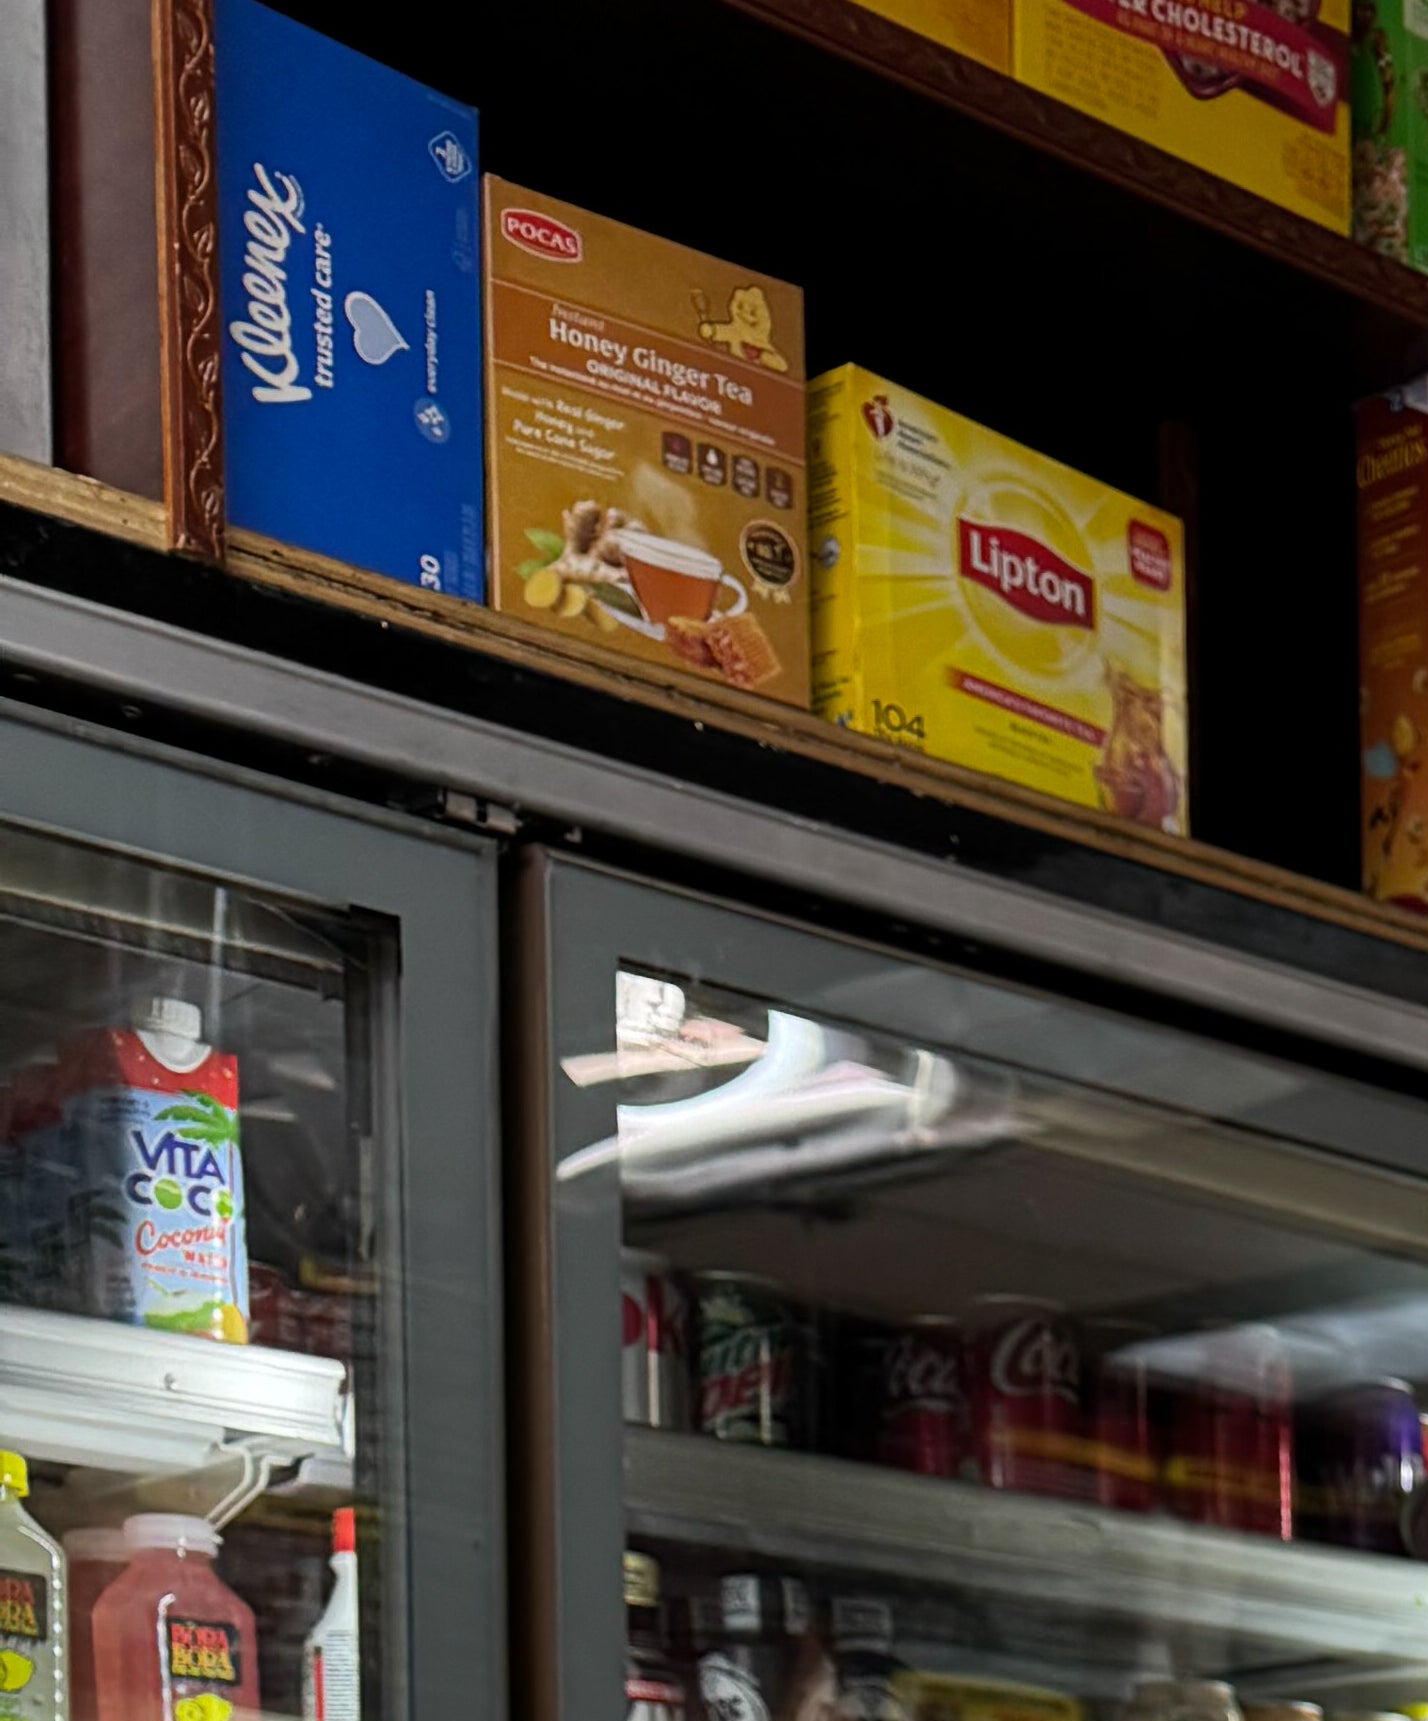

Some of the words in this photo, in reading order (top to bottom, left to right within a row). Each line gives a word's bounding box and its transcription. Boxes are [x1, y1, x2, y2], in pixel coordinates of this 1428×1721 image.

[1152, 3, 1304, 79] CHOLESTEROL
[314, 228, 333, 288] care
[506, 216, 577, 255] POCAS
[229, 162, 313, 403] Kleenex
[310, 287, 334, 388] trusted
[549, 318, 628, 366] Honey
[632, 348, 711, 389] Ginger
[713, 373, 754, 405] Tea
[586, 358, 659, 394] ORIGINAL
[663, 383, 723, 417] FLAVOR
[970, 529, 1085, 616] Lipton
[873, 699, 925, 739] 104
[131, 1130, 225, 1185] VITA
